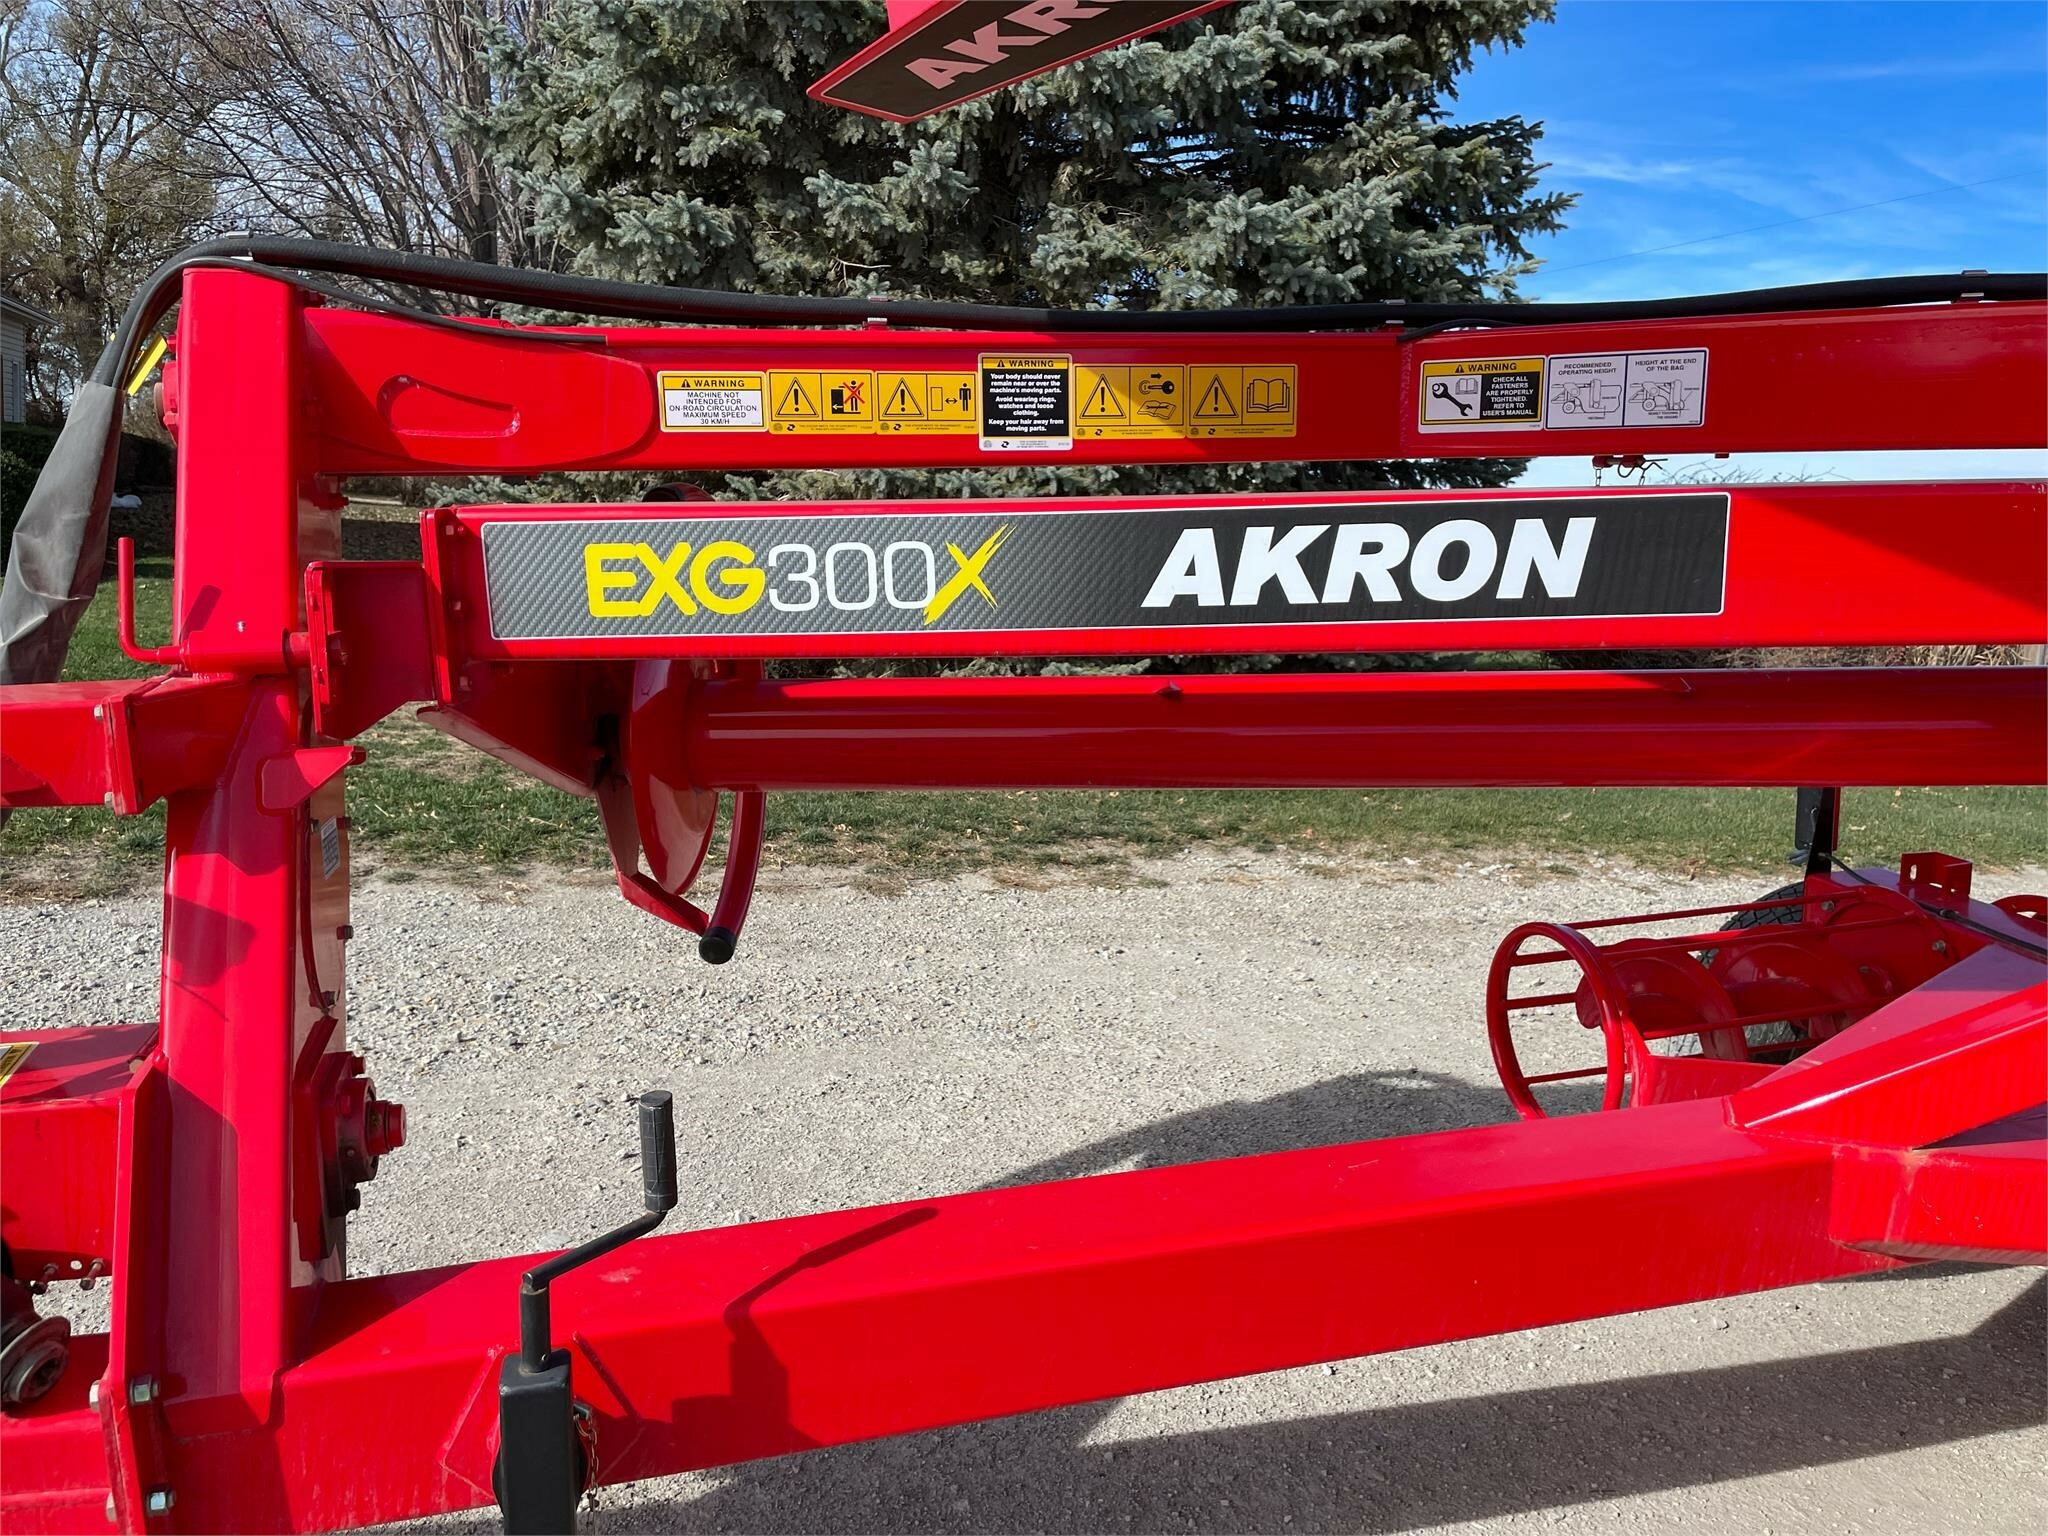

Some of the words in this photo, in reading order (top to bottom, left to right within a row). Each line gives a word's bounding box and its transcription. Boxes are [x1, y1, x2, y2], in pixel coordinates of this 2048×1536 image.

[905, 0, 1122, 90] AKR
[1468, 363, 1517, 372] WARNING
[1005, 373, 1020, 381] body
[694, 380, 745, 388] WARNING
[1140, 517, 1597, 608] AKRON
